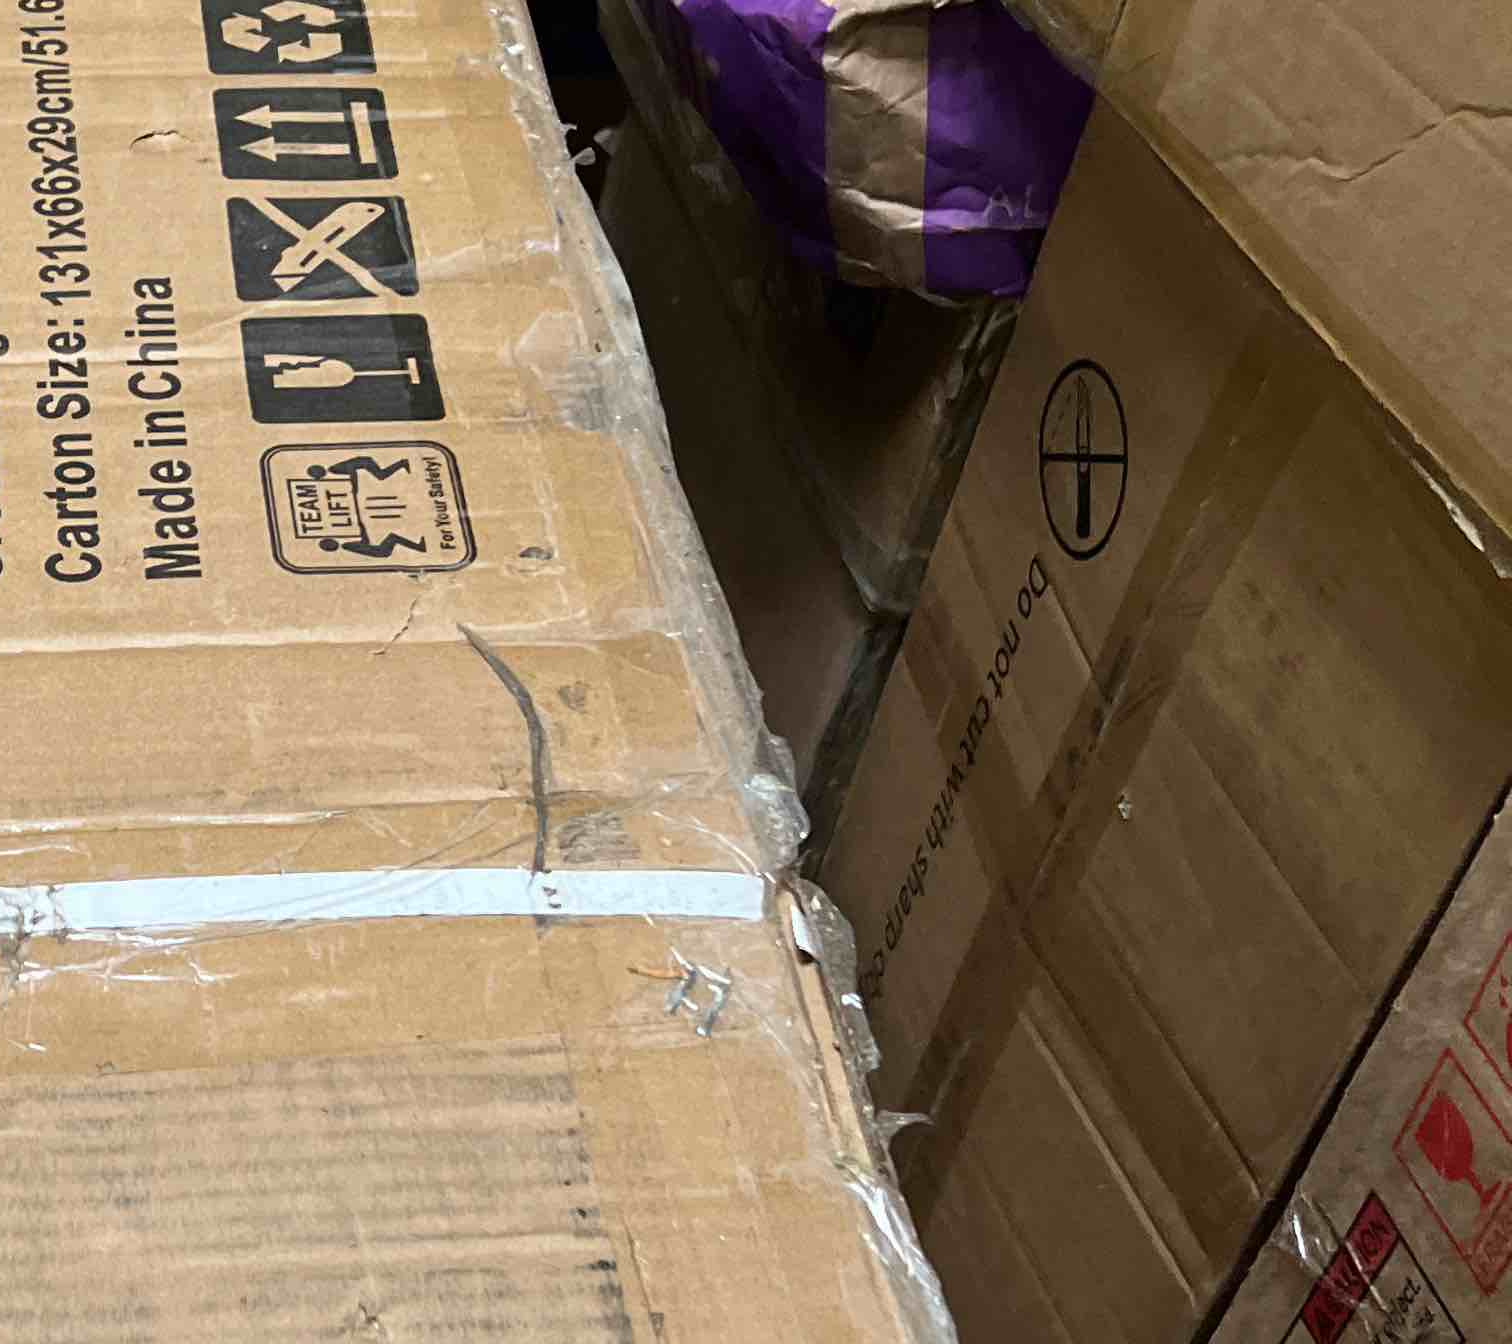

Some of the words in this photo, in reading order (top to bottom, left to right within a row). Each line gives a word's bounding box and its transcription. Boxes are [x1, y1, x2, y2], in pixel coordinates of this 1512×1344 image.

[124, 276, 182, 401] China
[133, 410, 188, 448] in
[42, 433, 103, 583] Carton
[137, 459, 203, 581] Made
[295, 484, 324, 534] TEAM
[326, 491, 353, 528] LIFT
[434, 500, 452, 528] Your
[438, 528, 457, 550] For
[1016, 554, 1049, 619] Do
[987, 626, 1021, 703] not
[957, 694, 992, 768] cut
[925, 762, 963, 852] with
[885, 850, 928, 952] sharp
